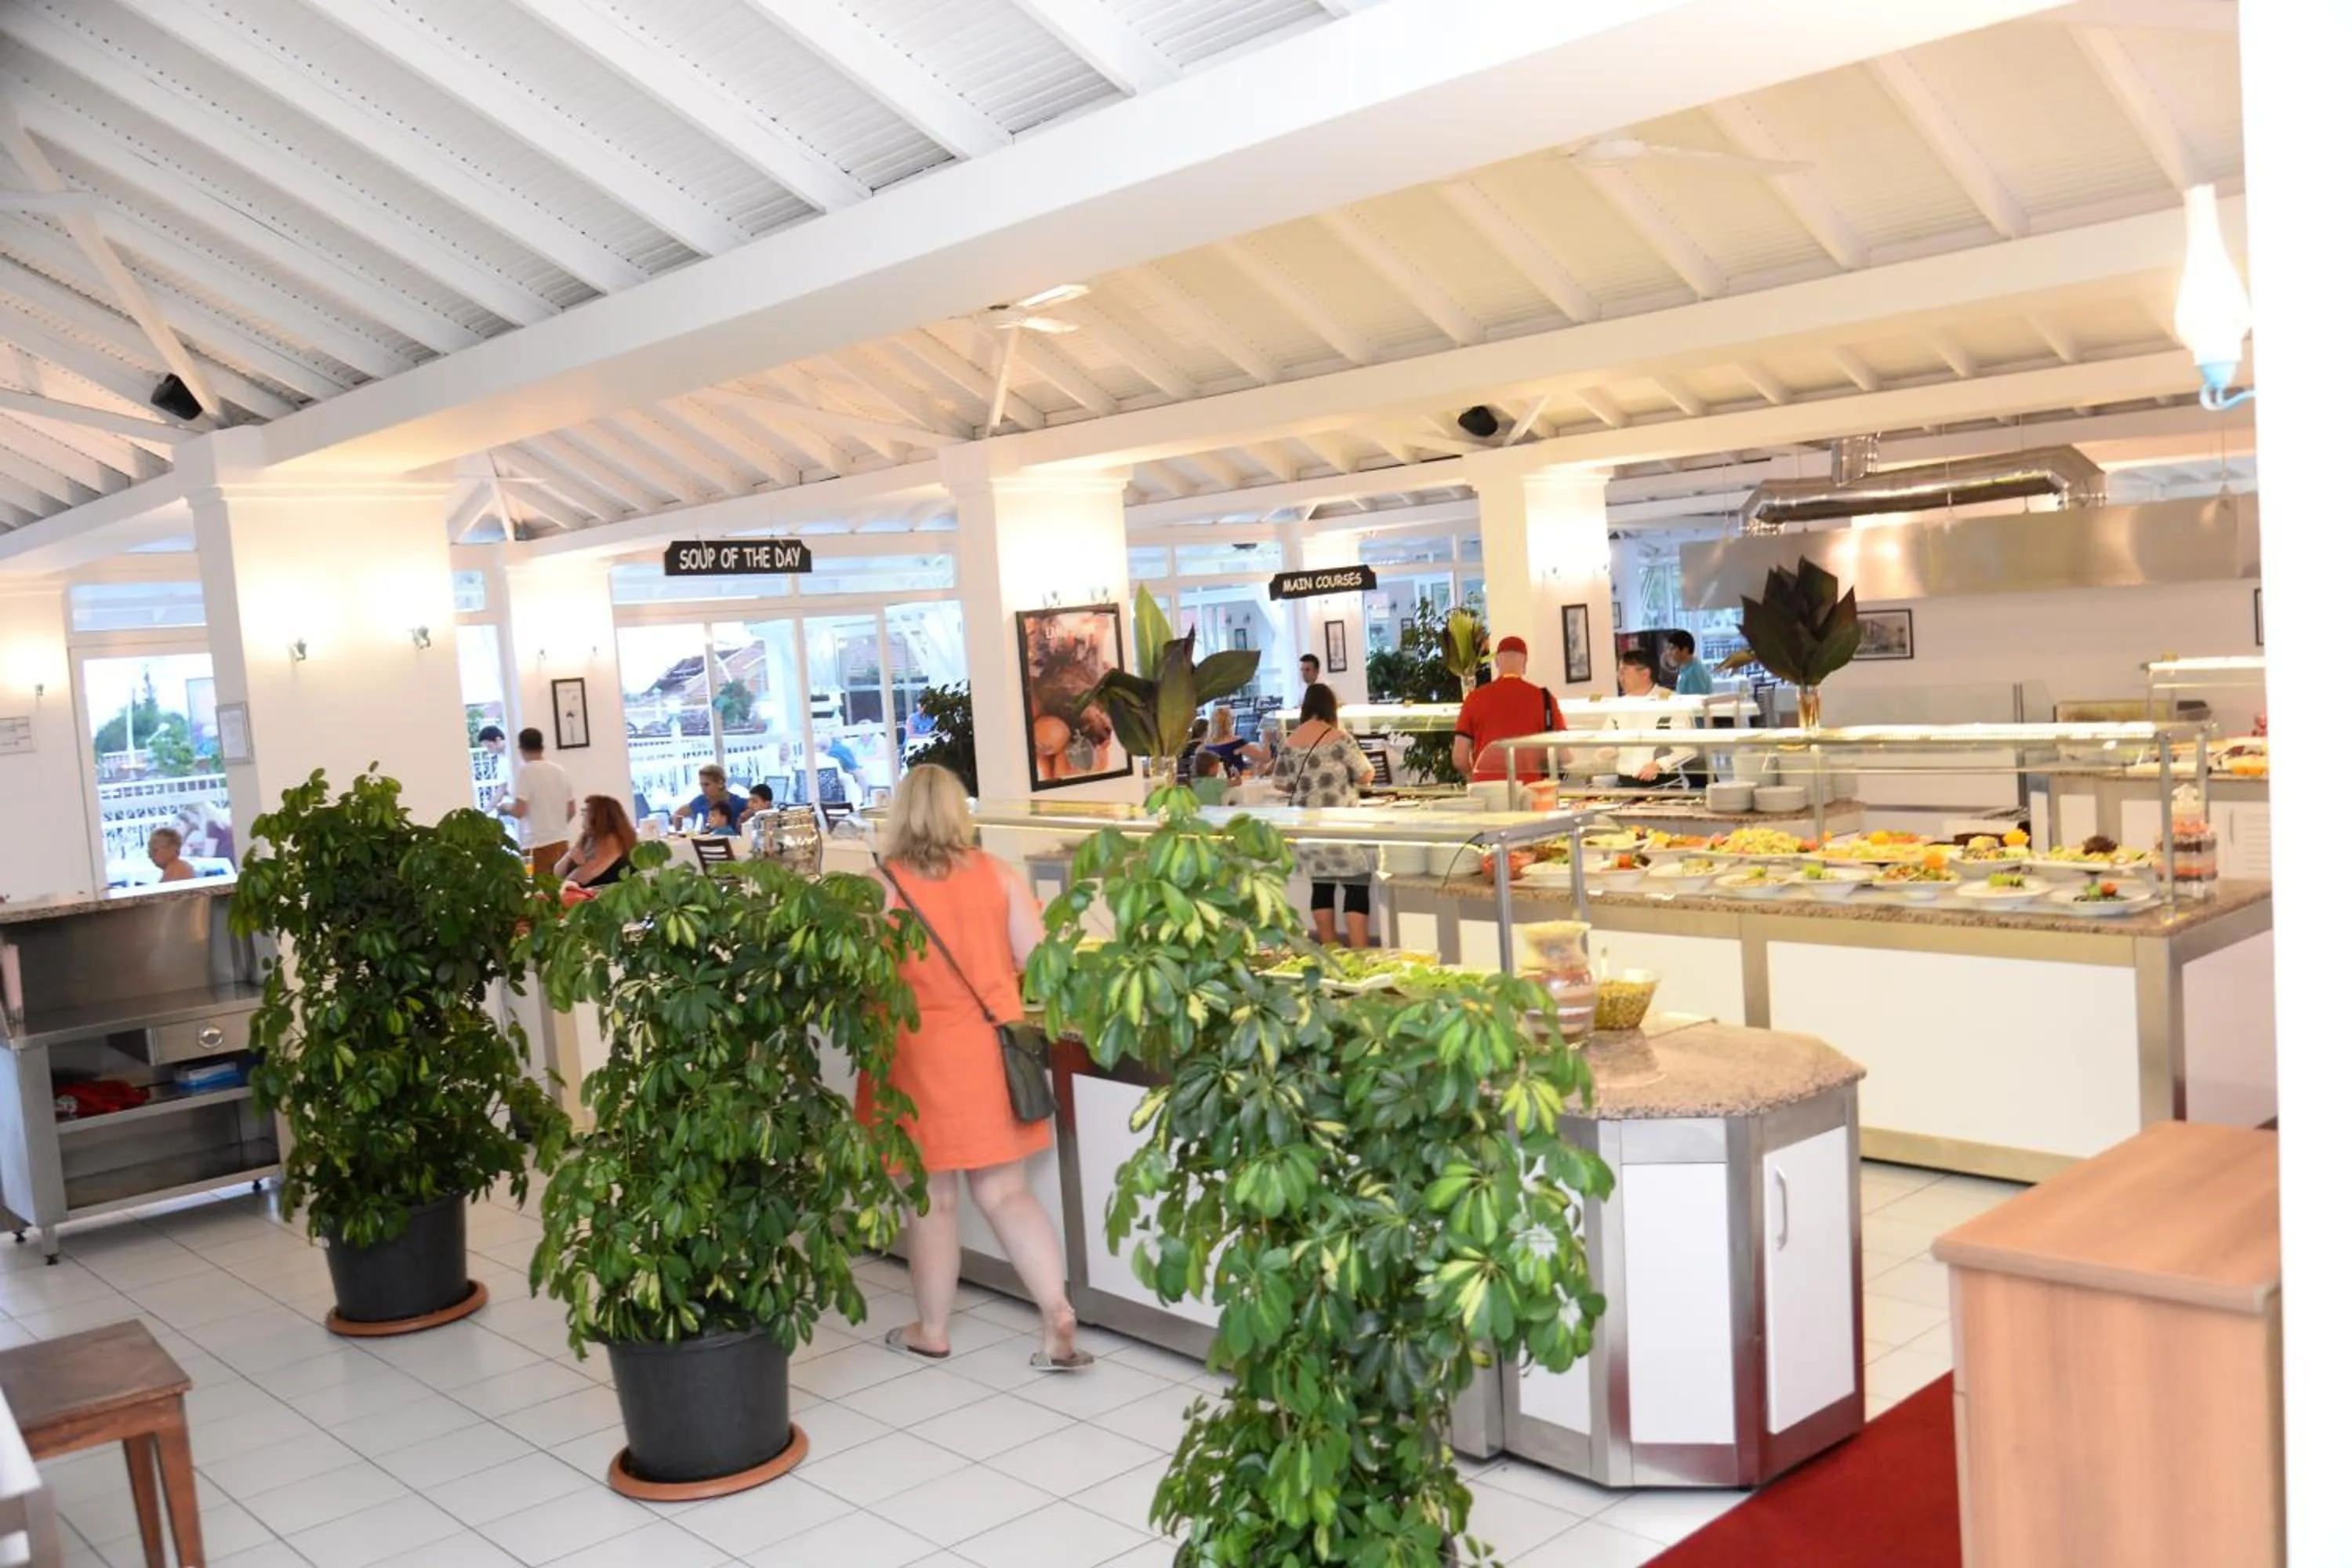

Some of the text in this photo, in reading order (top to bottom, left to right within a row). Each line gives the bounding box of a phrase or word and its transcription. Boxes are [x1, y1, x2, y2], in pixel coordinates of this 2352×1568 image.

[679, 546, 801, 570] SOUP OF THE DAY
[1282, 572, 1363, 593] MAIN COURSES
